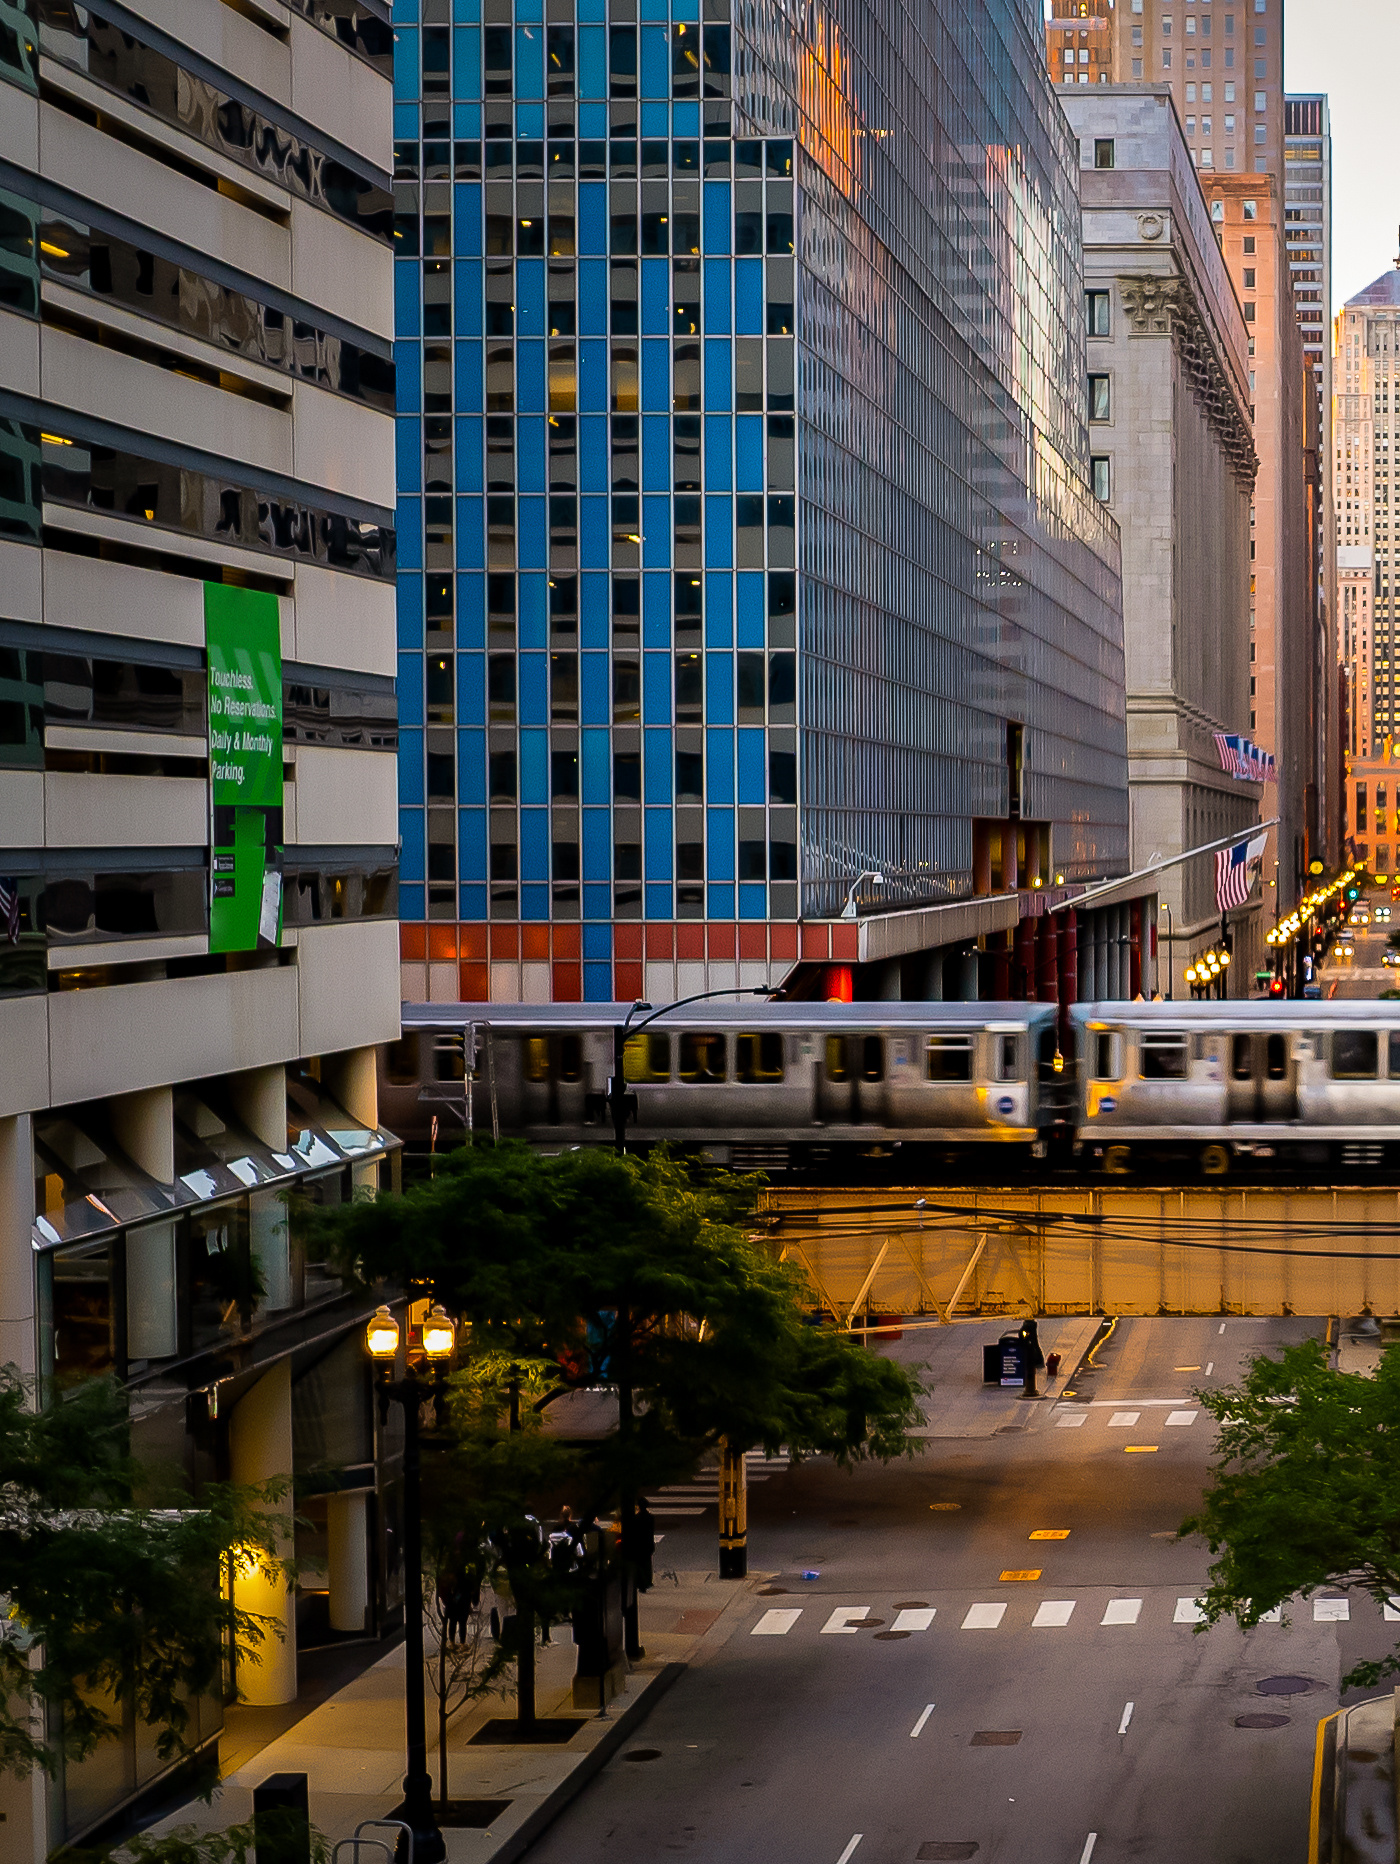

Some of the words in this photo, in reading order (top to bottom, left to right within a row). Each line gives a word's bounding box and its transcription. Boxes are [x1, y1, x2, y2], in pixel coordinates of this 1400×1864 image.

[211, 666, 254, 690] Touchless.
[211, 695, 222, 715] No
[224, 696, 277, 719] Reservations.
[212, 729, 232, 754] Daily
[234, 731, 240, 750] &
[242, 731, 273, 757] Monthly
[212, 760, 245, 785] Parking.
